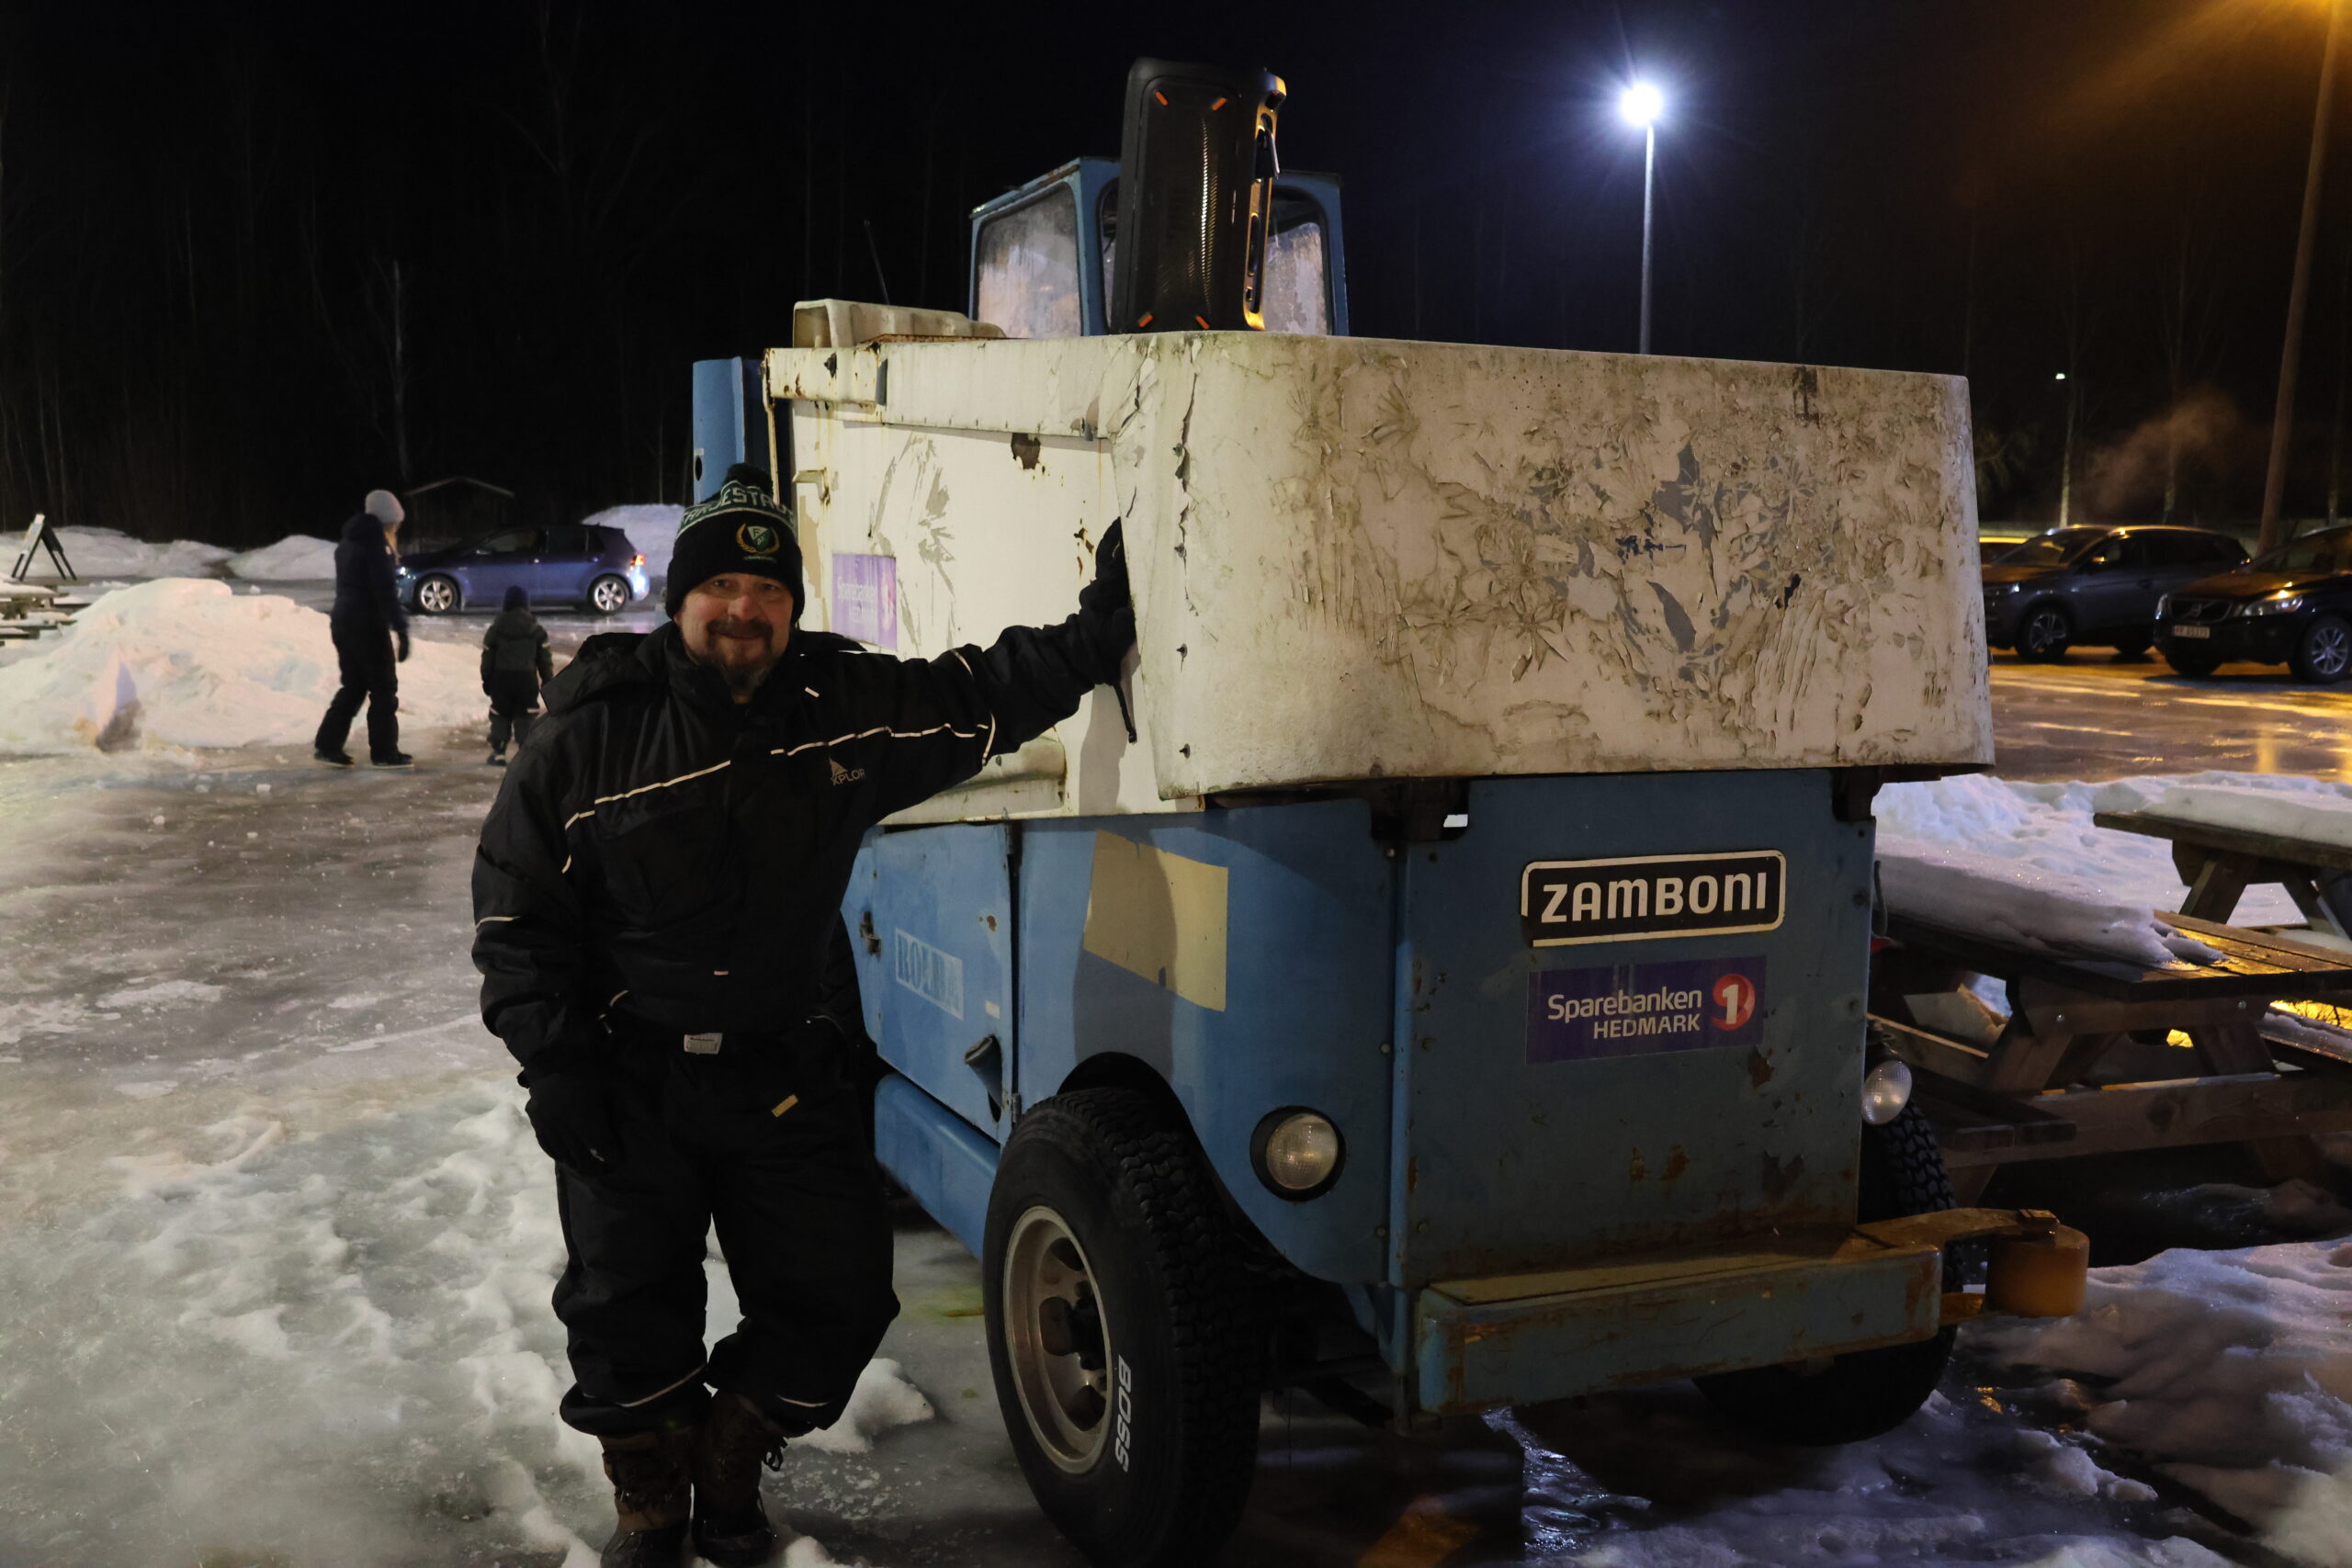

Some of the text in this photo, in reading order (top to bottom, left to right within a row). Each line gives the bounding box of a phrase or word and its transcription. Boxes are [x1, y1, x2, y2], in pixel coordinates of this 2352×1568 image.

[1541, 871, 1768, 923] ZAMBONI
[1547, 986, 1702, 1024] Sparebanken
[1722, 984, 1739, 1025] 1
[1593, 1014, 1702, 1040] HEDMARK
[1115, 1354, 1132, 1473] BOSS
